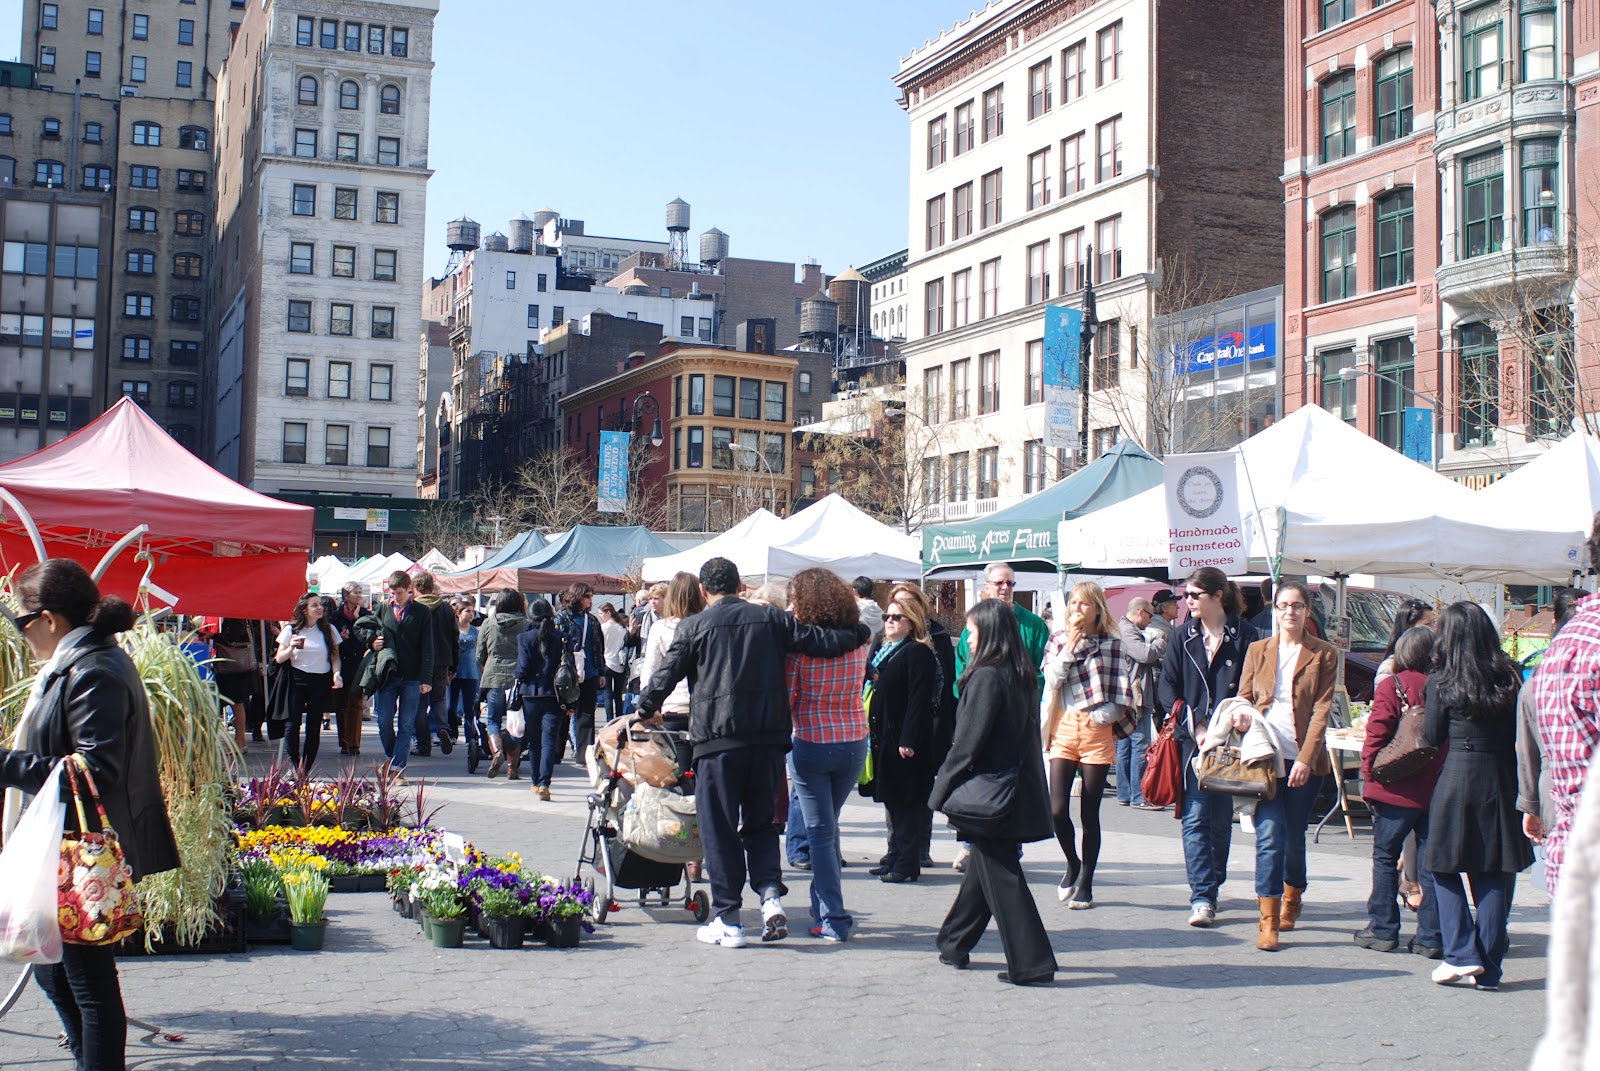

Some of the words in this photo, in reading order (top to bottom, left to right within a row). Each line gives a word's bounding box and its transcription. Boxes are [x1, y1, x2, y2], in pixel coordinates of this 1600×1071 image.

[1248, 343, 1265, 355] ank
[1054, 407, 1071, 416] UNION
[1050, 416, 1072, 426] SQUARE
[1169, 525, 1238, 538] Handmade
[930, 530, 977, 563] Roaming
[978, 529, 1010, 560] Acres
[1011, 528, 1051, 558] Farm
[1169, 539, 1241, 552] Farmstead
[1179, 556, 1234, 568] Cheeses
[593, 576, 622, 590] Migh
